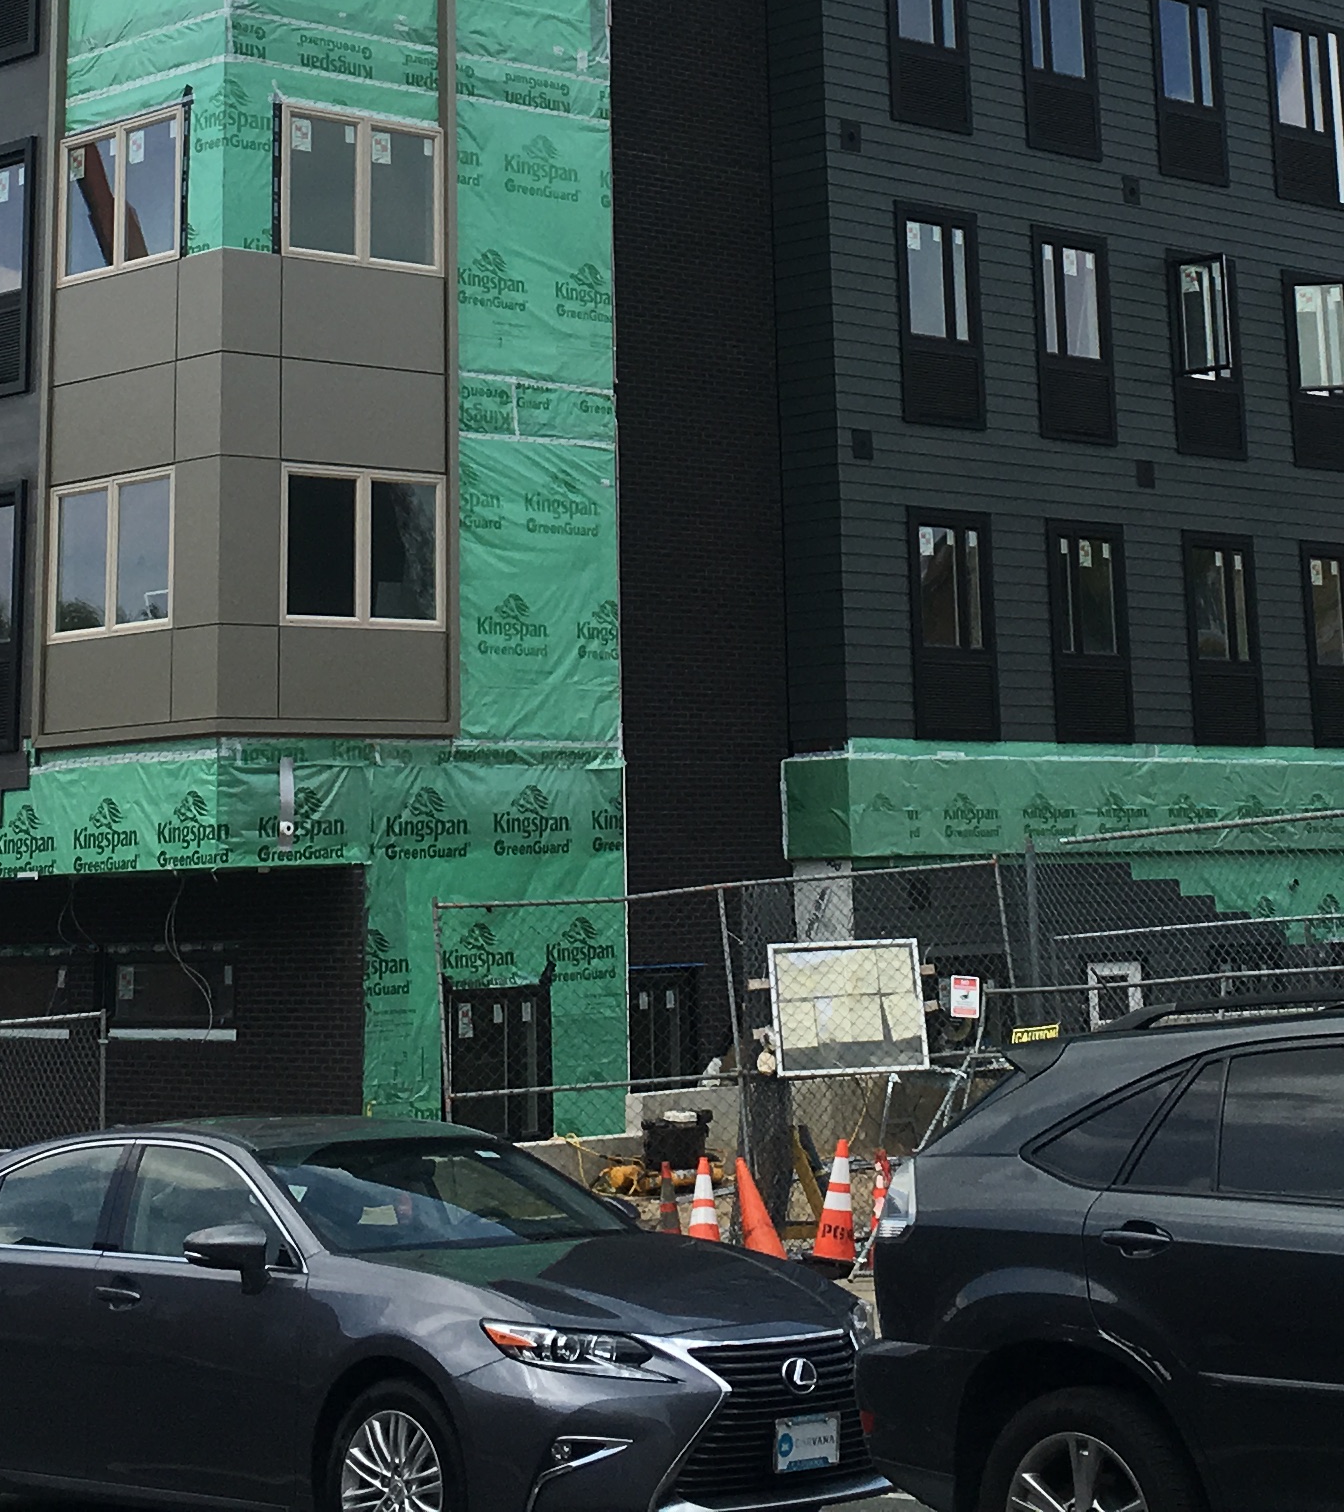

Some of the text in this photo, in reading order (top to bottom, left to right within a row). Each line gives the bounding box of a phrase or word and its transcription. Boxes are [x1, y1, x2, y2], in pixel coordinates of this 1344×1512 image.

[193, 107, 273, 136] Kingspan
[194, 134, 273, 154] GreenGuard
[504, 154, 579, 185] Kingspan
[504, 179, 579, 203] GreenGuard
[457, 268, 526, 297] Kingspan
[555, 281, 611, 308] Kingspa
[458, 292, 528, 312] GreenGuard
[516, 397, 551, 410] Guard
[579, 399, 613, 415] Green
[524, 492, 600, 519] Kingspan
[526, 520, 600, 538] GreenGuard
[477, 618, 549, 642] Kingspan
[576, 621, 618, 646] Kings
[478, 640, 548, 658] GreenGuard
[578, 645, 619, 661] GreenG
[157, 820, 229, 849] Kingspan
[258, 816, 345, 843] Kigspan
[386, 816, 469, 843] Kingspan
[493, 811, 569, 840] Kingspan
[73, 827, 138, 854] Kingspan
[385, 842, 470, 860] GreenGuard
[494, 839, 571, 856] GreenGuard
[73, 854, 139, 873] GreenGuard
[157, 849, 233, 869] GreenGuard
[257, 843, 346, 863] GreenGuard
[442, 948, 514, 974] Kingspan
[546, 941, 616, 968] Kingspan
